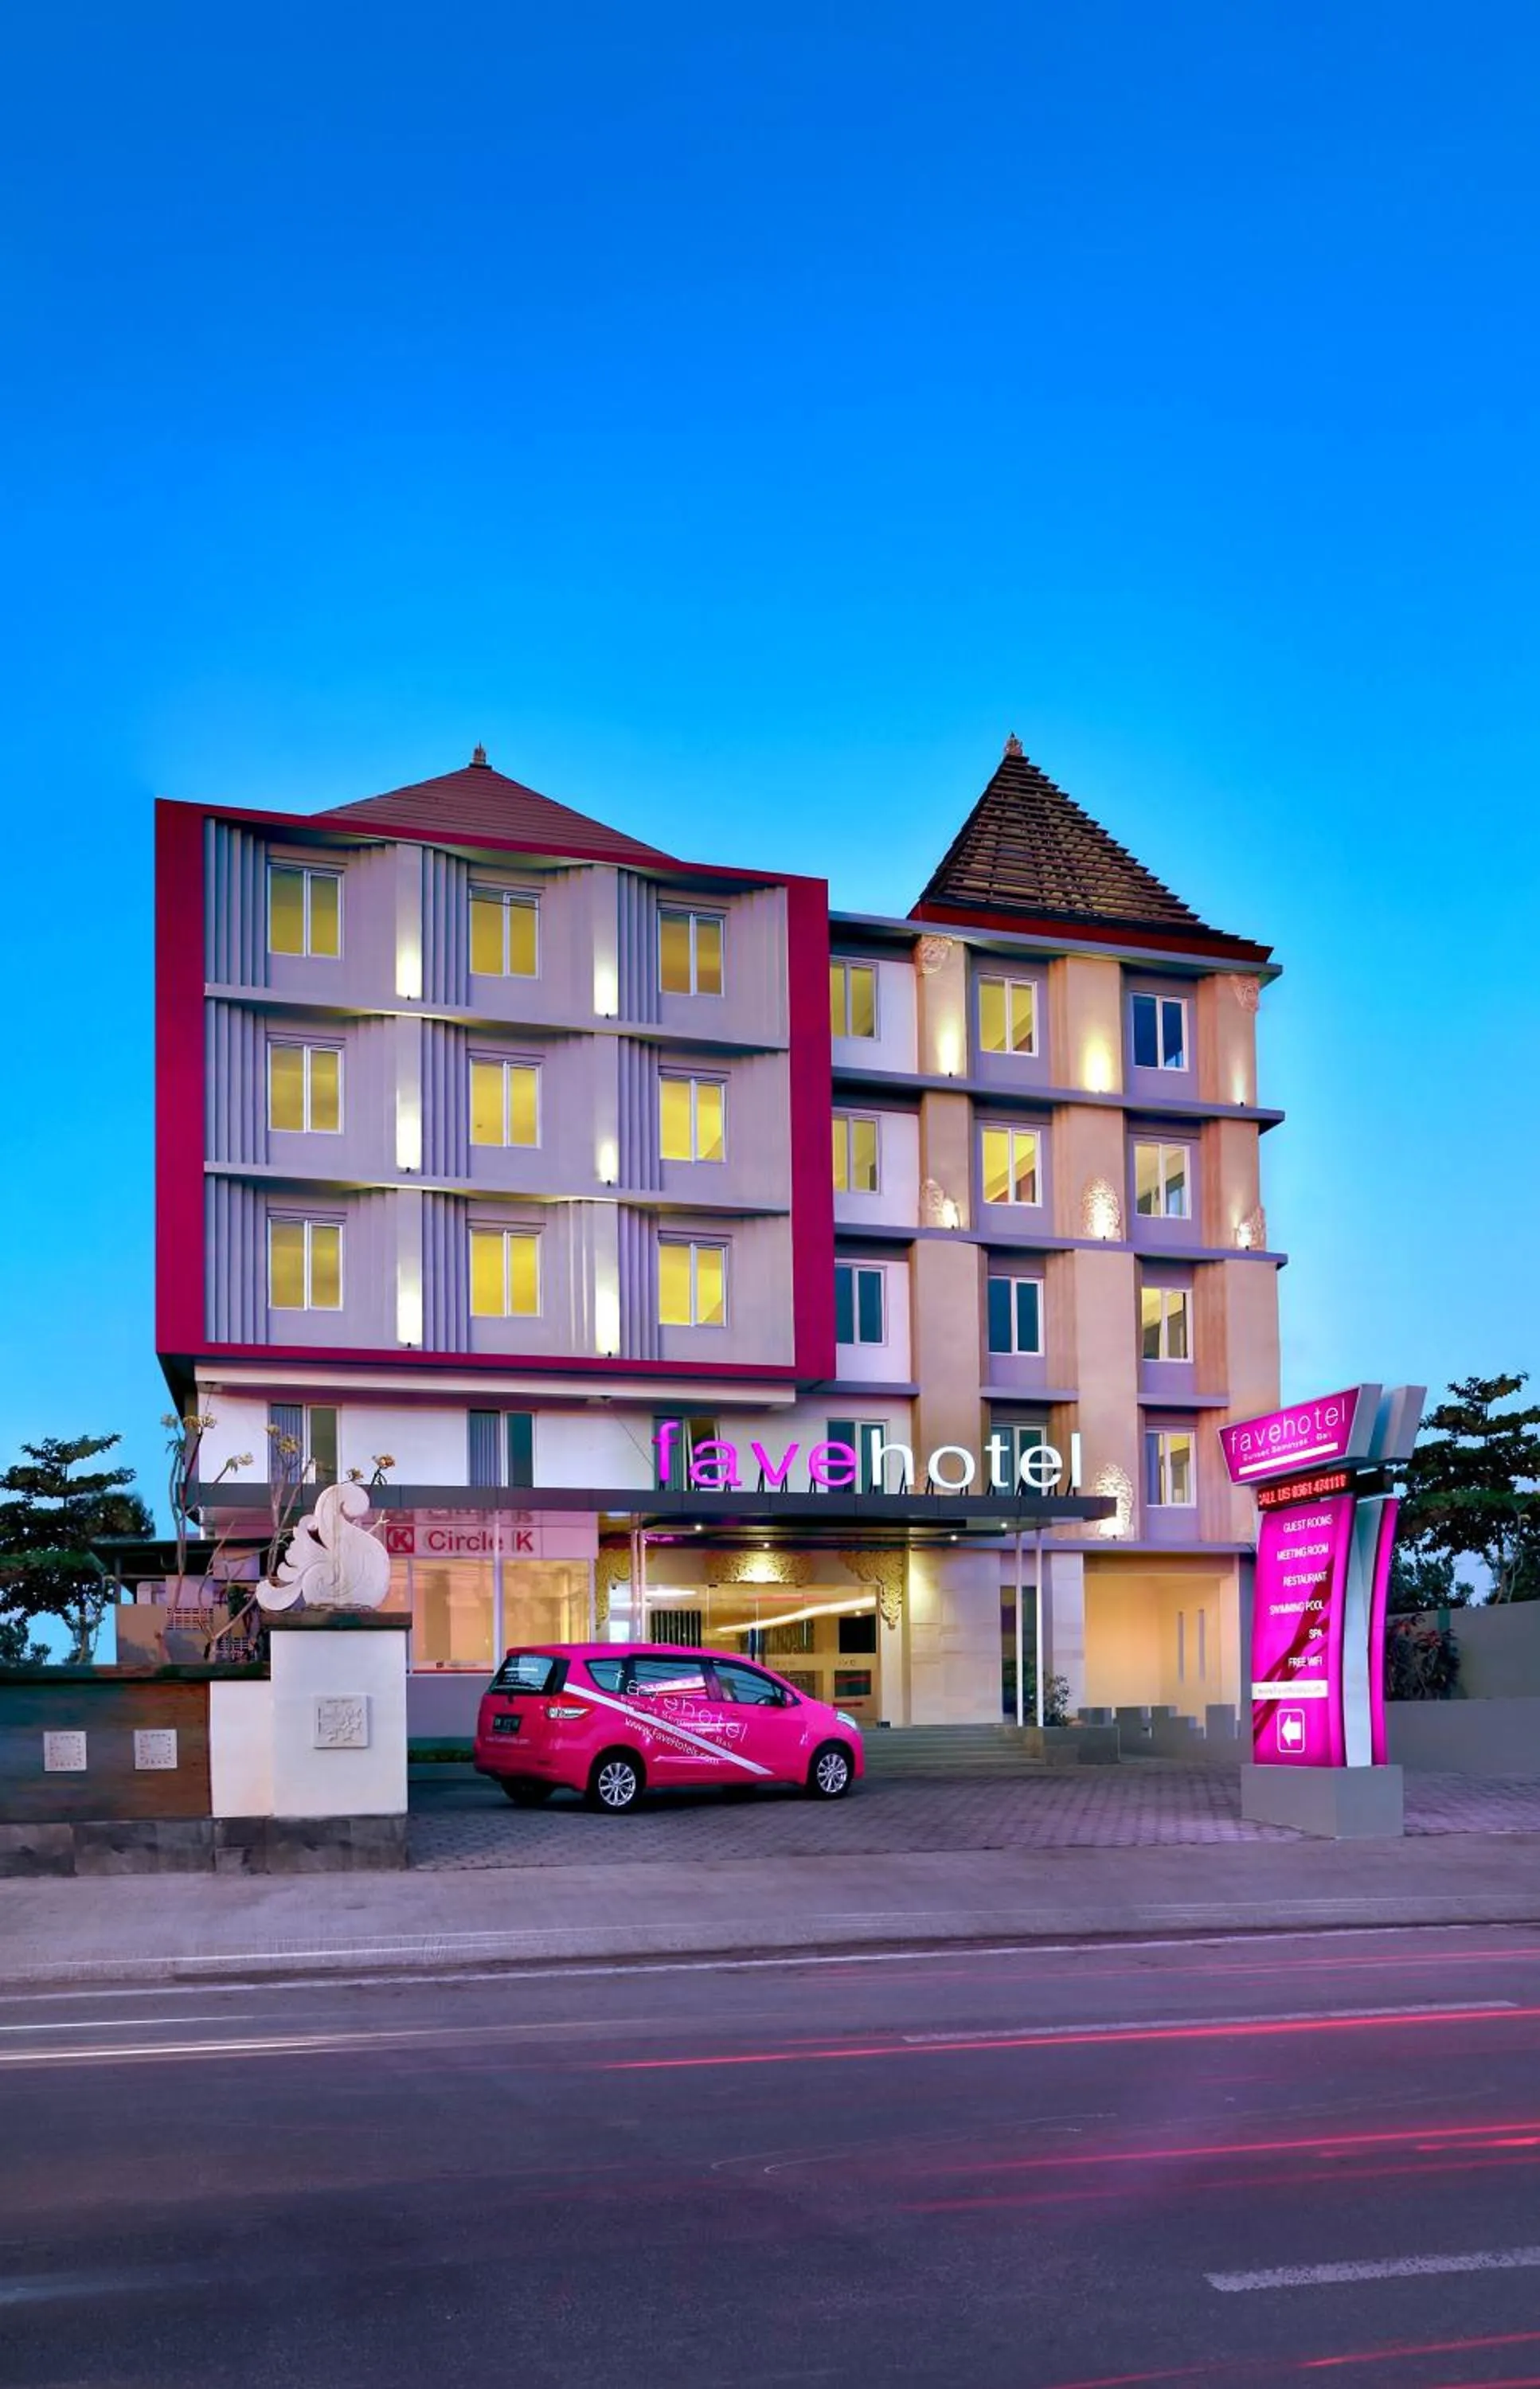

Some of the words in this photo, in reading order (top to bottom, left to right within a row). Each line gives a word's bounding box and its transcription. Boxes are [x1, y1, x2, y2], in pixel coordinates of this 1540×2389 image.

[1231, 1398, 1345, 1453] favehotel
[651, 1421, 1081, 1488] favehotel
[1283, 1519, 1307, 1534] GUEST
[1307, 1514, 1333, 1528] ROOMS
[1276, 1546, 1307, 1562] MEETING
[1307, 1542, 1329, 1555] ROOM
[1283, 1570, 1327, 1587] RESTAURANT
[1305, 1600, 1323, 1612] POOL
[1308, 1629, 1323, 1640] SPA
[1288, 1657, 1306, 1668] FREE
